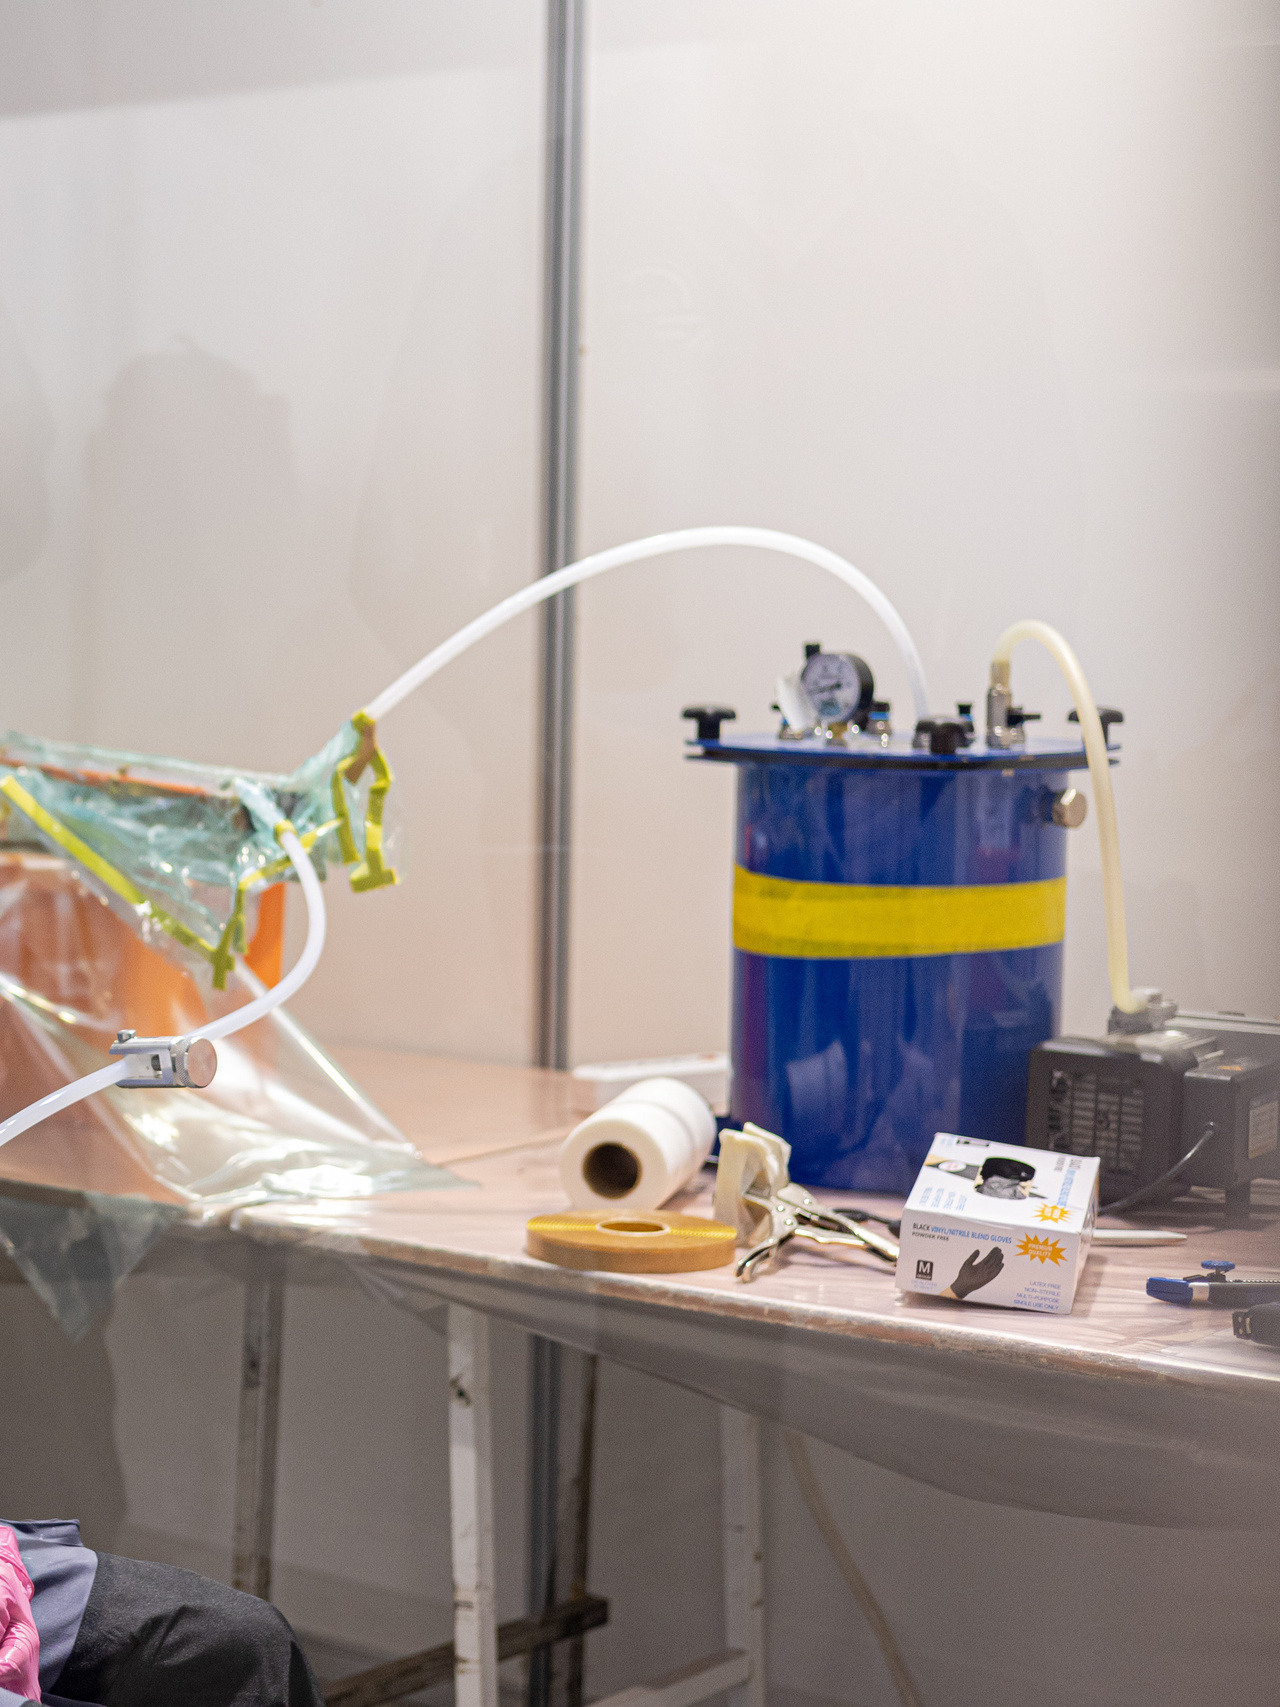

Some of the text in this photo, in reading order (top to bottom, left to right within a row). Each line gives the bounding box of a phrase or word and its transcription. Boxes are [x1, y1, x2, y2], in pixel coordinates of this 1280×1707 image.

[912, 1222, 1012, 1244] BLACK VINYL/NITRILE BLEND GLOVES
[912, 1231, 949, 1241] POWDER FREE
[918, 1260, 931, 1274] M
